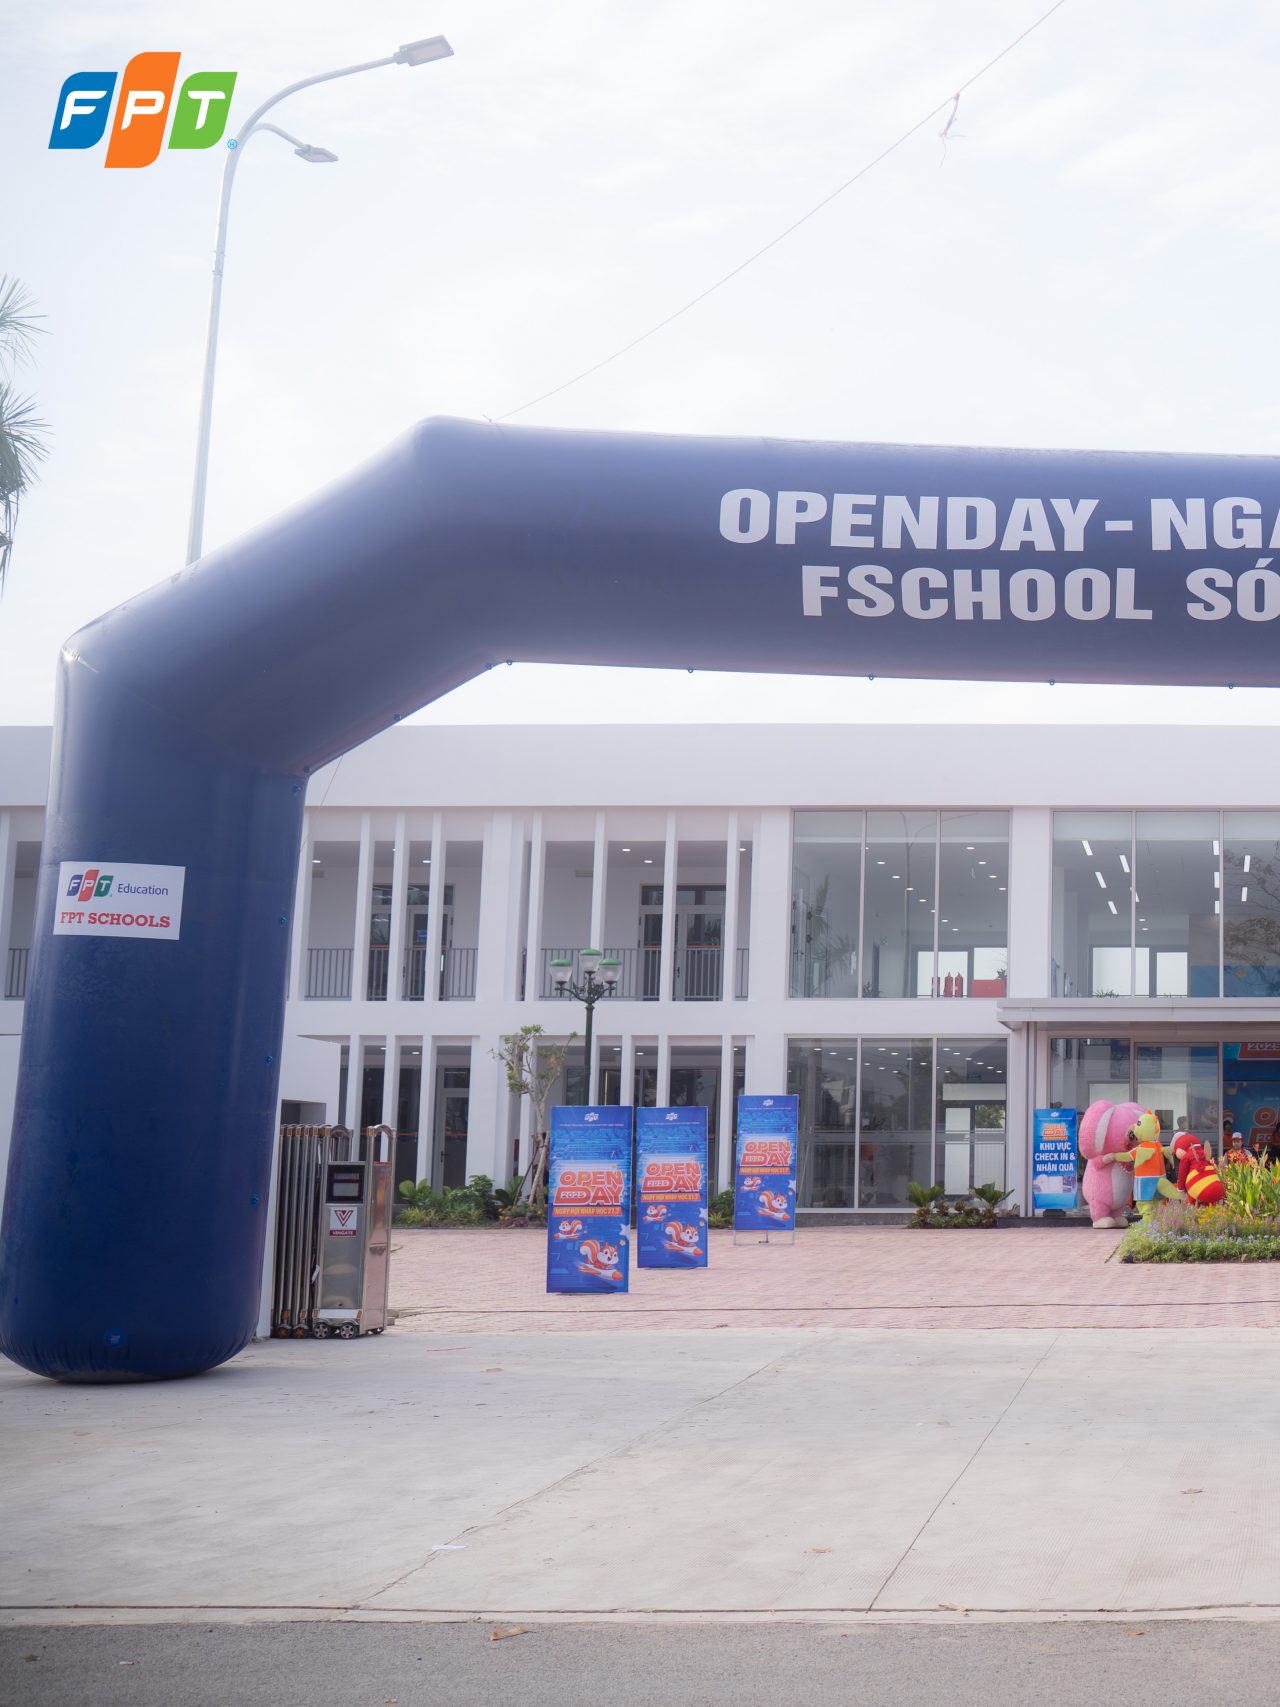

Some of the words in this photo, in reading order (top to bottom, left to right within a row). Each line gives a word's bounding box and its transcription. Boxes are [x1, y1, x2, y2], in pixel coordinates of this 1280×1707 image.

[801, 564, 1153, 621] FSCHOOL
[117, 883, 169, 896] Education
[60, 912, 85, 924] FPT
[88, 912, 171, 928] SCHOOLS
[744, 1141, 791, 1153] OPEN
[1040, 1142, 1055, 1150] KHU
[1057, 1142, 1072, 1152] VỰC
[741, 1152, 791, 1166] DAY
[1034, 1152, 1059, 1161] CHECK
[1060, 1152, 1069, 1160] IN
[1069, 1152, 1076, 1160] &
[645, 1162, 701, 1176] OPEN
[1036, 1162, 1058, 1174] NHẬN
[559, 1170, 623, 1187] OPEN
[641, 1175, 702, 1192] DAY
[554, 1185, 624, 1205] DAY
